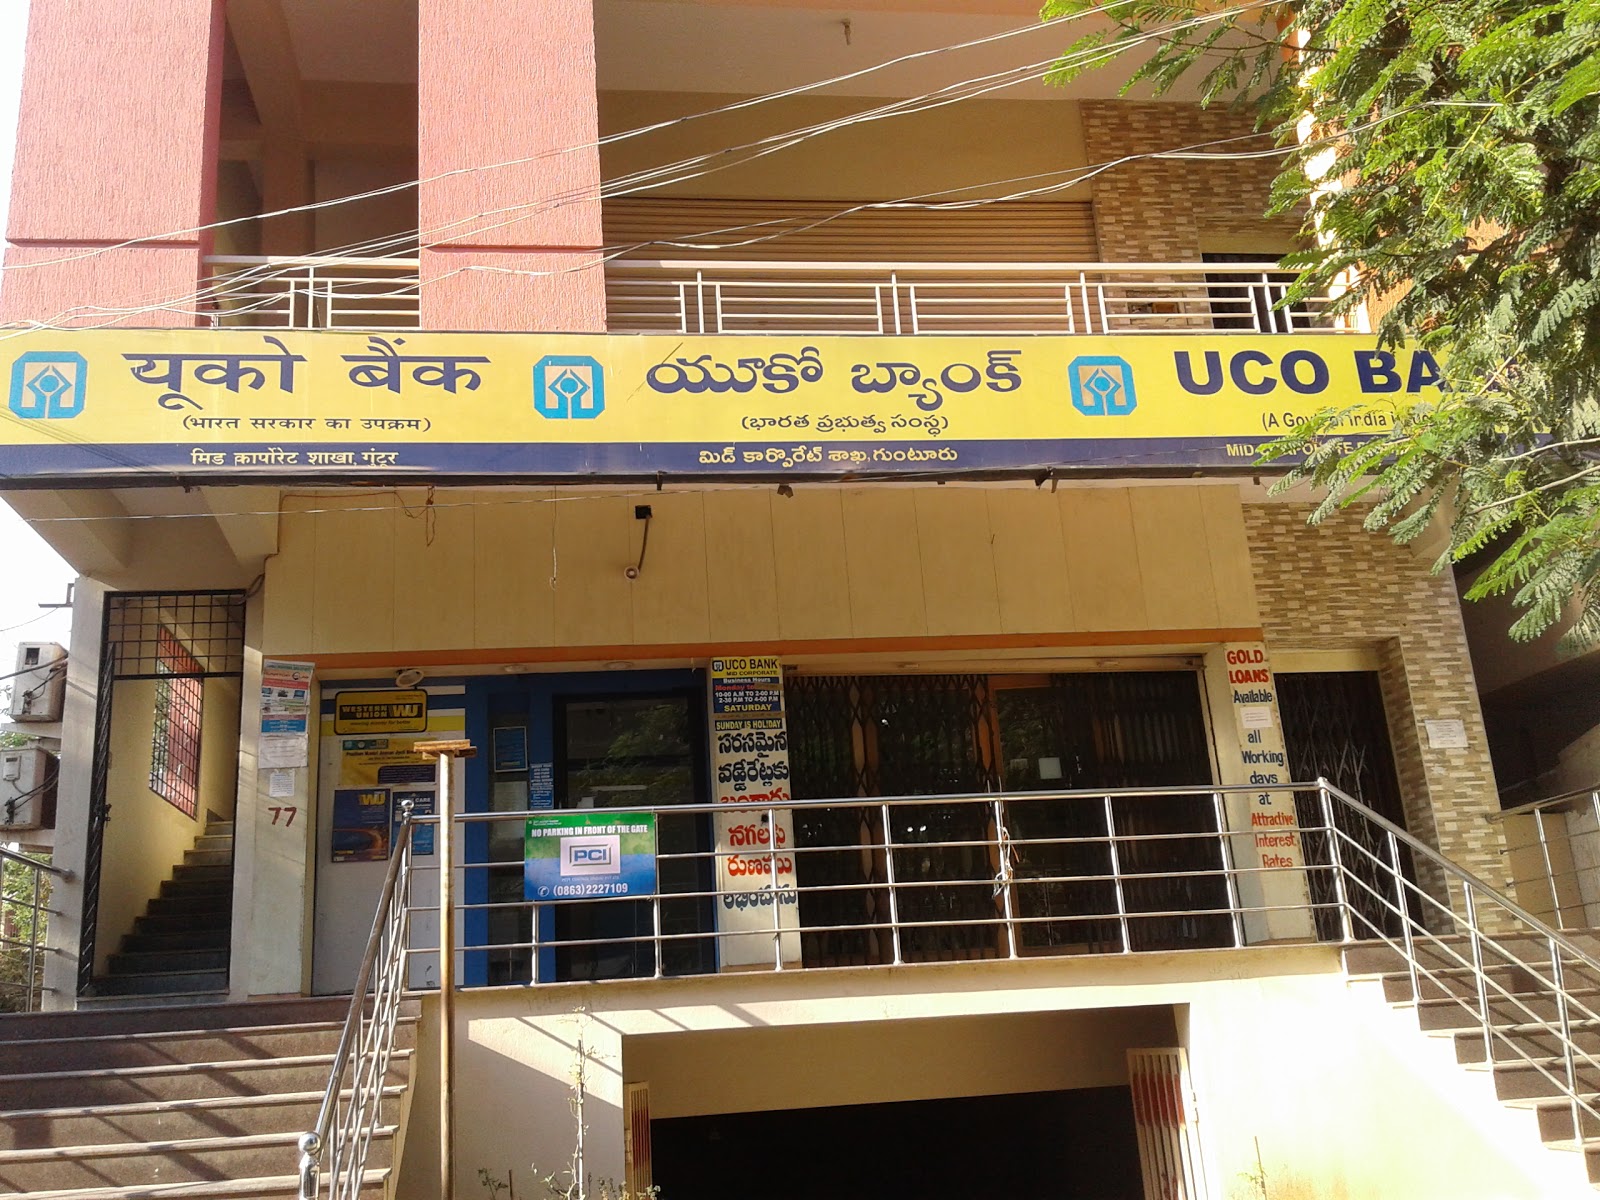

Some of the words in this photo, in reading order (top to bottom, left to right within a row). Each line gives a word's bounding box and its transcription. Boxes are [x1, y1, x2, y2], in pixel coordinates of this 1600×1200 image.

[121, 336, 308, 410] यूको
[340, 336, 491, 394] बैंक
[645, 346, 825, 394] యూకో
[850, 349, 1022, 412] బ్యాంక్
[1173, 350, 1330, 395] UCO
[1354, 350, 1470, 394] BA
[182, 415, 241, 430] (भारत
[249, 418, 316, 430] सरकार
[325, 418, 352, 430] का
[360, 417, 432, 432] उपक्रम)
[741, 415, 810, 431] (భారత
[816, 415, 886, 433] ప్రభుత్వ
[1262, 412, 1279, 431] (A
[190, 447, 226, 465] मिड
[233, 447, 299, 465] कार्पोरेट
[361, 447, 399, 468] गुंटूर
[699, 447, 736, 464] మిడ్
[725, 658, 747, 670] UCO
[749, 658, 778, 669] BANK
[1226, 649, 1264, 665] GOLD
[1228, 669, 1269, 684] LOANS
[1233, 689, 1273, 703] Available
[390, 704, 419, 717] WU
[724, 704, 772, 712] SATURDAY
[716, 721, 743, 730] SUNDAY
[752, 720, 781, 729] HOLIDAY
[1247, 729, 1262, 743] all
[718, 731, 787, 758] సరసమైన
[1241, 750, 1284, 767] Working
[718, 758, 789, 792] వడ్డీరేట్లకు
[1250, 771, 1278, 785] days
[1258, 791, 1272, 805] at
[1251, 812, 1294, 827] Attractive
[531, 829, 541, 837] NO
[543, 827, 573, 836] PARKING
[575, 826, 583, 835] IN
[584, 825, 606, 835] FRONT
[607, 825, 616, 834] OF
[617, 825, 630, 834] THE
[631, 824, 648, 833] GATE
[574, 849, 607, 862] PCI
[1262, 854, 1294, 868] Rates
[553, 882, 628, 897] (0863)2227109
[723, 884, 797, 911] లభంచును
